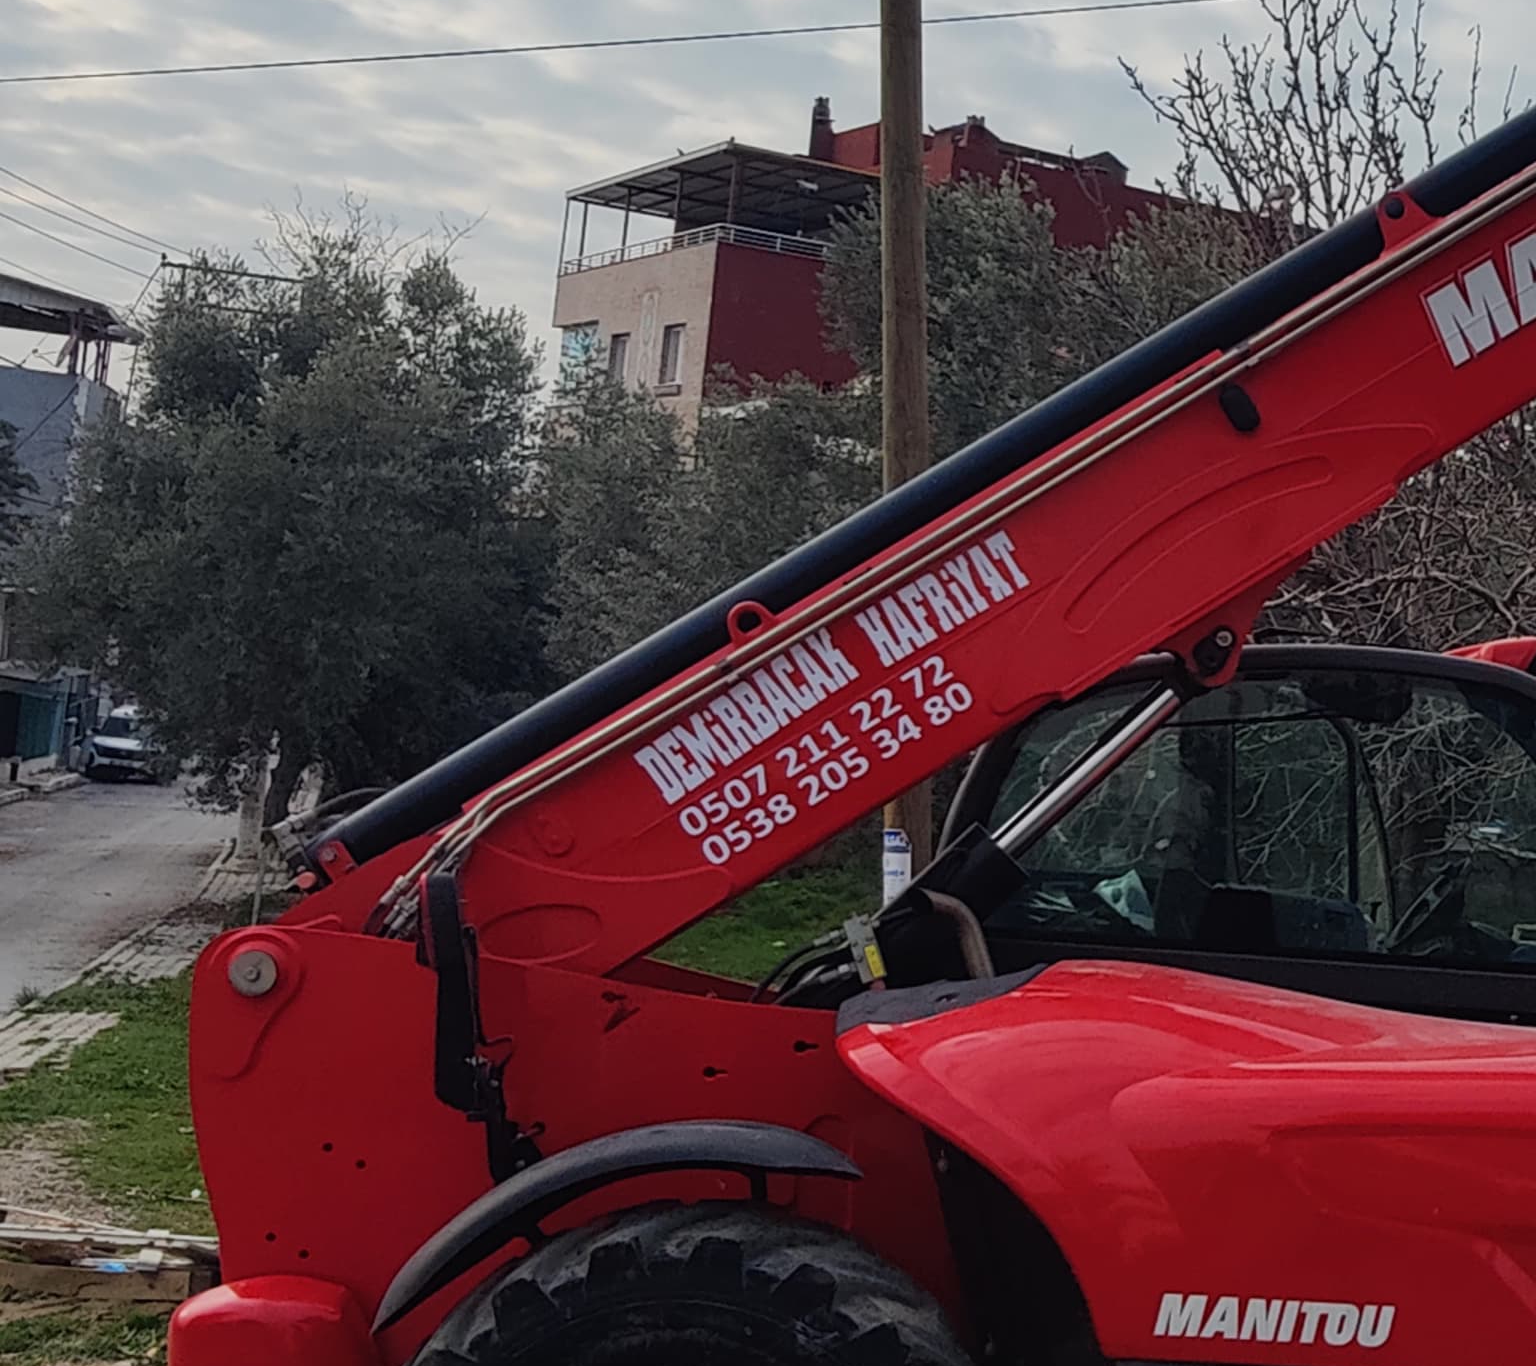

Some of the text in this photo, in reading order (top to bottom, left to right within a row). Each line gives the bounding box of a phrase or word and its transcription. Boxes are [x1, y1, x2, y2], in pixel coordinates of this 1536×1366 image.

[678, 654, 954, 837] 0507 211 22 72
[701, 681, 974, 866] 0538 205 34 80
[1153, 1292, 1395, 1348] MANITOU
